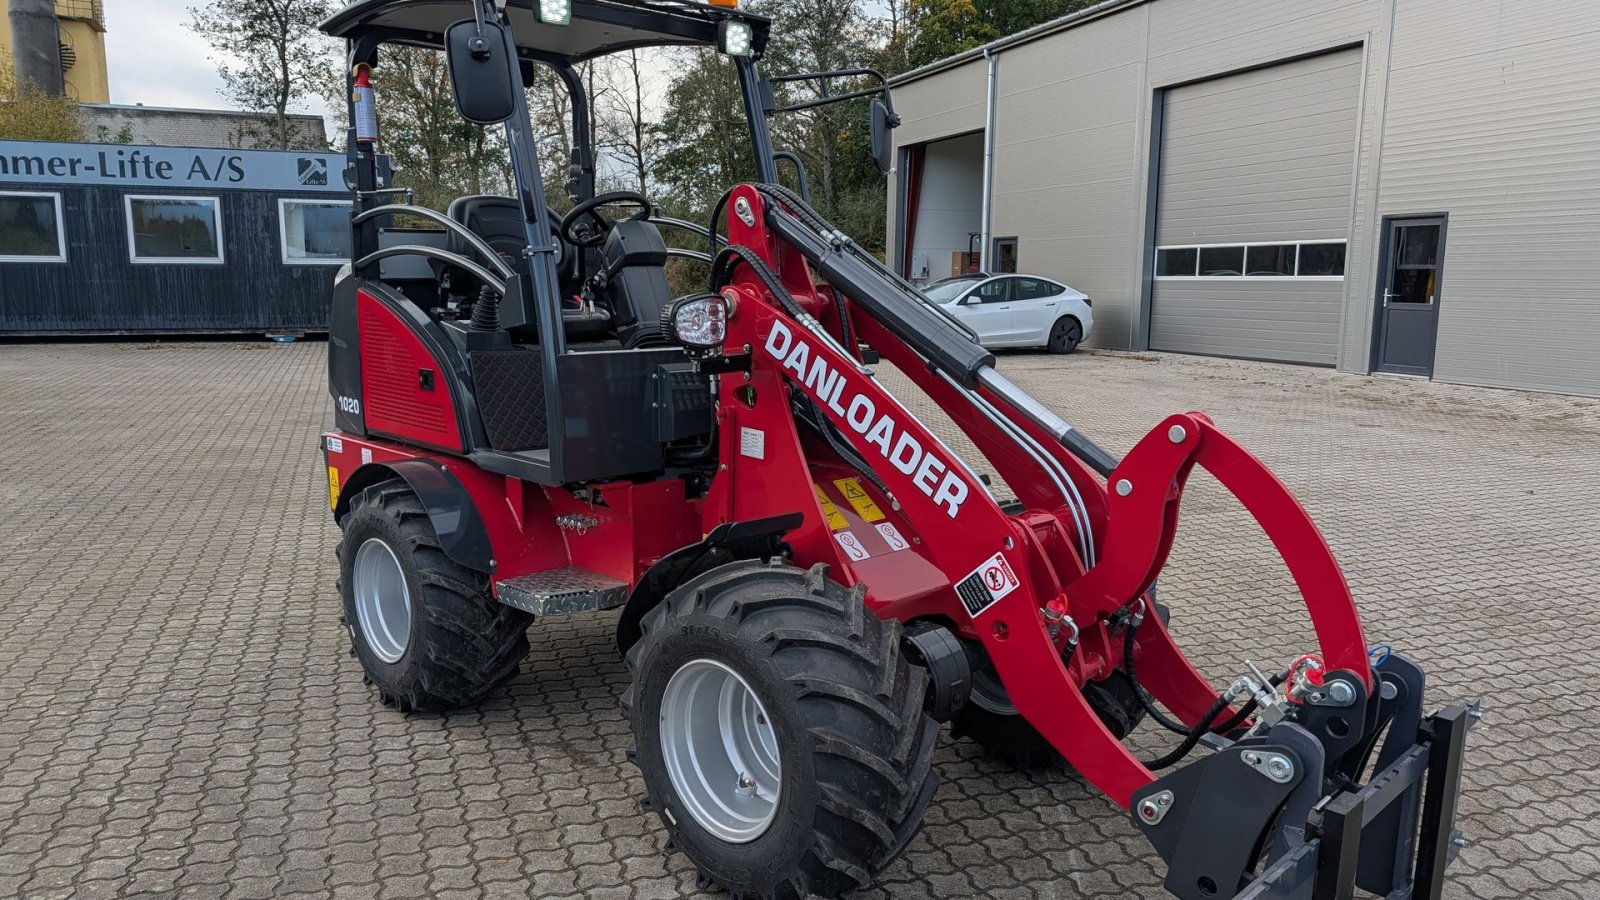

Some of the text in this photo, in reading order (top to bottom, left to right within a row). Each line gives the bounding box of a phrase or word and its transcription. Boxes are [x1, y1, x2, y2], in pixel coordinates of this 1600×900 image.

[0, 149, 245, 182] mer-Lifte A/S
[338, 395, 360, 415] 1020
[764, 318, 970, 519] DANLOADER
